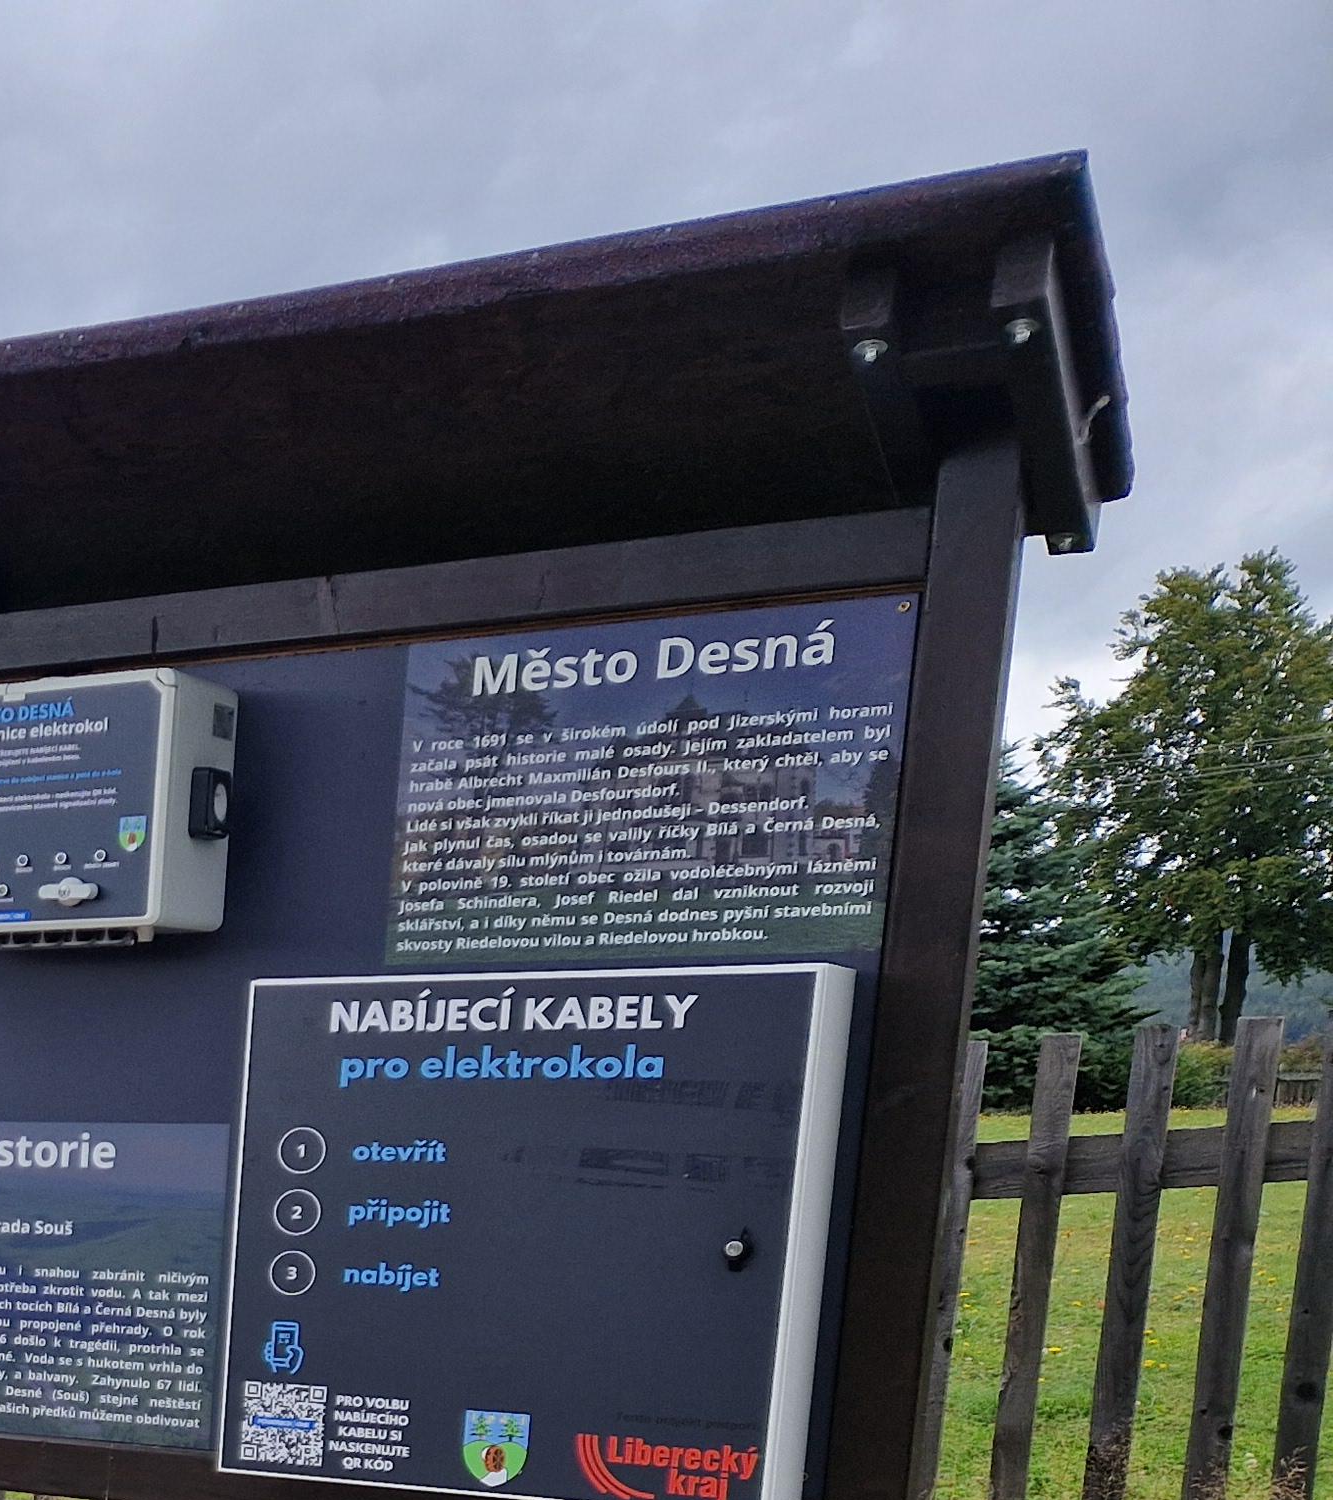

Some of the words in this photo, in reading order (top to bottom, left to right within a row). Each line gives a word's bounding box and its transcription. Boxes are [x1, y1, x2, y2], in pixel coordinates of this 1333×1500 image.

[472, 647, 638, 697] Město
[657, 619, 835, 680] Desná
[19, 697, 74, 720] DESNÁ
[30, 717, 109, 738] elektrokol
[412, 739, 423, 751] V
[431, 738, 463, 749] roce
[472, 732, 506, 746] 1691
[516, 732, 533, 743] se
[542, 731, 552, 741] v
[561, 723, 626, 740] širokém
[636, 718, 678, 734] údolí
[686, 715, 719, 734] pod
[727, 707, 818, 731] Jizerskými
[828, 702, 893, 720] horami
[410, 756, 456, 771] začala
[465, 753, 498, 770] psát
[506, 748, 566, 764] historie
[574, 744, 615, 760] malé
[622, 741, 676, 757] osady.
[682, 737, 727, 756] Jejím
[735, 729, 853, 749] zakladatelem
[863, 724, 891, 742] byl
[410, 776, 452, 791] hrabě
[457, 771, 523, 788] Albrecht
[528, 766, 611, 783] Maxmilián
[617, 762, 690, 778] Desfours
[723, 754, 769, 772] který
[774, 751, 823, 768] chtěl,
[829, 749, 862, 766] aby
[868, 750, 889, 762] se
[408, 796, 443, 811] nová
[447, 795, 483, 809] obec
[484, 789, 566, 810] jmenovala
[571, 782, 680, 801] Desfoursdorf.
[402, 837, 427, 854] Jak
[433, 835, 480, 853] plynul
[486, 834, 515, 848] čas,
[521, 830, 578, 845] osadou
[584, 831, 602, 842] se
[608, 826, 652, 842] valily
[657, 823, 699, 840] říčky
[706, 821, 738, 836] Bílá
[744, 823, 755, 834] a
[762, 817, 814, 833] Černá
[820, 813, 881, 830] Desná,
[397, 897, 444, 914] Josefa
[457, 894, 541, 909] Schindlera,
[553, 890, 595, 908] Josef
[607, 888, 658, 903] Riedel
[671, 886, 698, 900] dal
[712, 883, 800, 899] vzniknout
[813, 879, 874, 896] rozvoji
[397, 916, 465, 930] sklářství,
[469, 918, 479, 928] a
[483, 915, 489, 928] i
[493, 914, 526, 930] díky
[530, 913, 575, 926] němu
[579, 914, 598, 924] se
[602, 909, 653, 924] Desná
[657, 908, 719, 922] dodnes
[722, 905, 769, 923] pyšní
[772, 901, 872, 918] stavebními
[396, 937, 453, 952] skvosty
[455, 934, 539, 948] Riedelovou
[540, 933, 581, 946] vilou
[583, 935, 594, 945] a
[598, 930, 688, 944] Riedelovou
[691, 927, 769, 942] hrobkou.
[329, 986, 516, 1032] NABÍJECÍ
[523, 994, 699, 1031] KABELY
[338, 1056, 409, 1088] pro
[419, 1044, 665, 1079] elektrokola
[297, 1143, 306, 1158] 1
[352, 1139, 447, 1162] otevřít
[291, 1205, 302, 1220] 2
[348, 1199, 451, 1229] připojit
[34, 1220, 73, 1236] Souš
[286, 1266, 297, 1280] 3
[343, 1262, 440, 1292] nabíjet
[42, 1283, 84, 1296] zkrotit
[132, 1288, 141, 1298] A
[148, 1288, 170, 1300] tak
[176, 1290, 208, 1302] mezi
[15, 1300, 52, 1312] tocích
[56, 1301, 79, 1313] Bílá
[83, 1305, 91, 1314] a
[92, 1302, 131, 1316] Černá
[135, 1306, 175, 1318] Desná
[179, 1307, 207, 1322] byly
[19, 1318, 81, 1332] propojené
[162, 1325, 173, 1336] O
[183, 1326, 205, 1338] rok
[13, 1334, 46, 1346] došlo
[53, 1336, 61, 1347] k
[128, 1342, 181, 1354] protrhla
[189, 1346, 204, 1356] se
[5, 1386, 42, 1398] Desné
[52, 1389, 89, 1403] (Souš)
[99, 1392, 138, 1406] stejné
[149, 1395, 200, 1409] neštěstí
[336, 1395, 364, 1408] PRO
[365, 1396, 410, 1411] VOLBU
[32, 1404, 75, 1418] předků
[78, 1408, 132, 1422] můžeme
[135, 1412, 200, 1427] obdivovat
[334, 1408, 410, 1427] NABÍJECÍHO
[338, 1425, 388, 1440] KABELU
[390, 1429, 403, 1441] SI
[329, 1440, 410, 1458] NASKENUJTE
[607, 1435, 758, 1480] Liberecký
[343, 1456, 362, 1470] QR
[364, 1456, 394, 1472] KÓD
